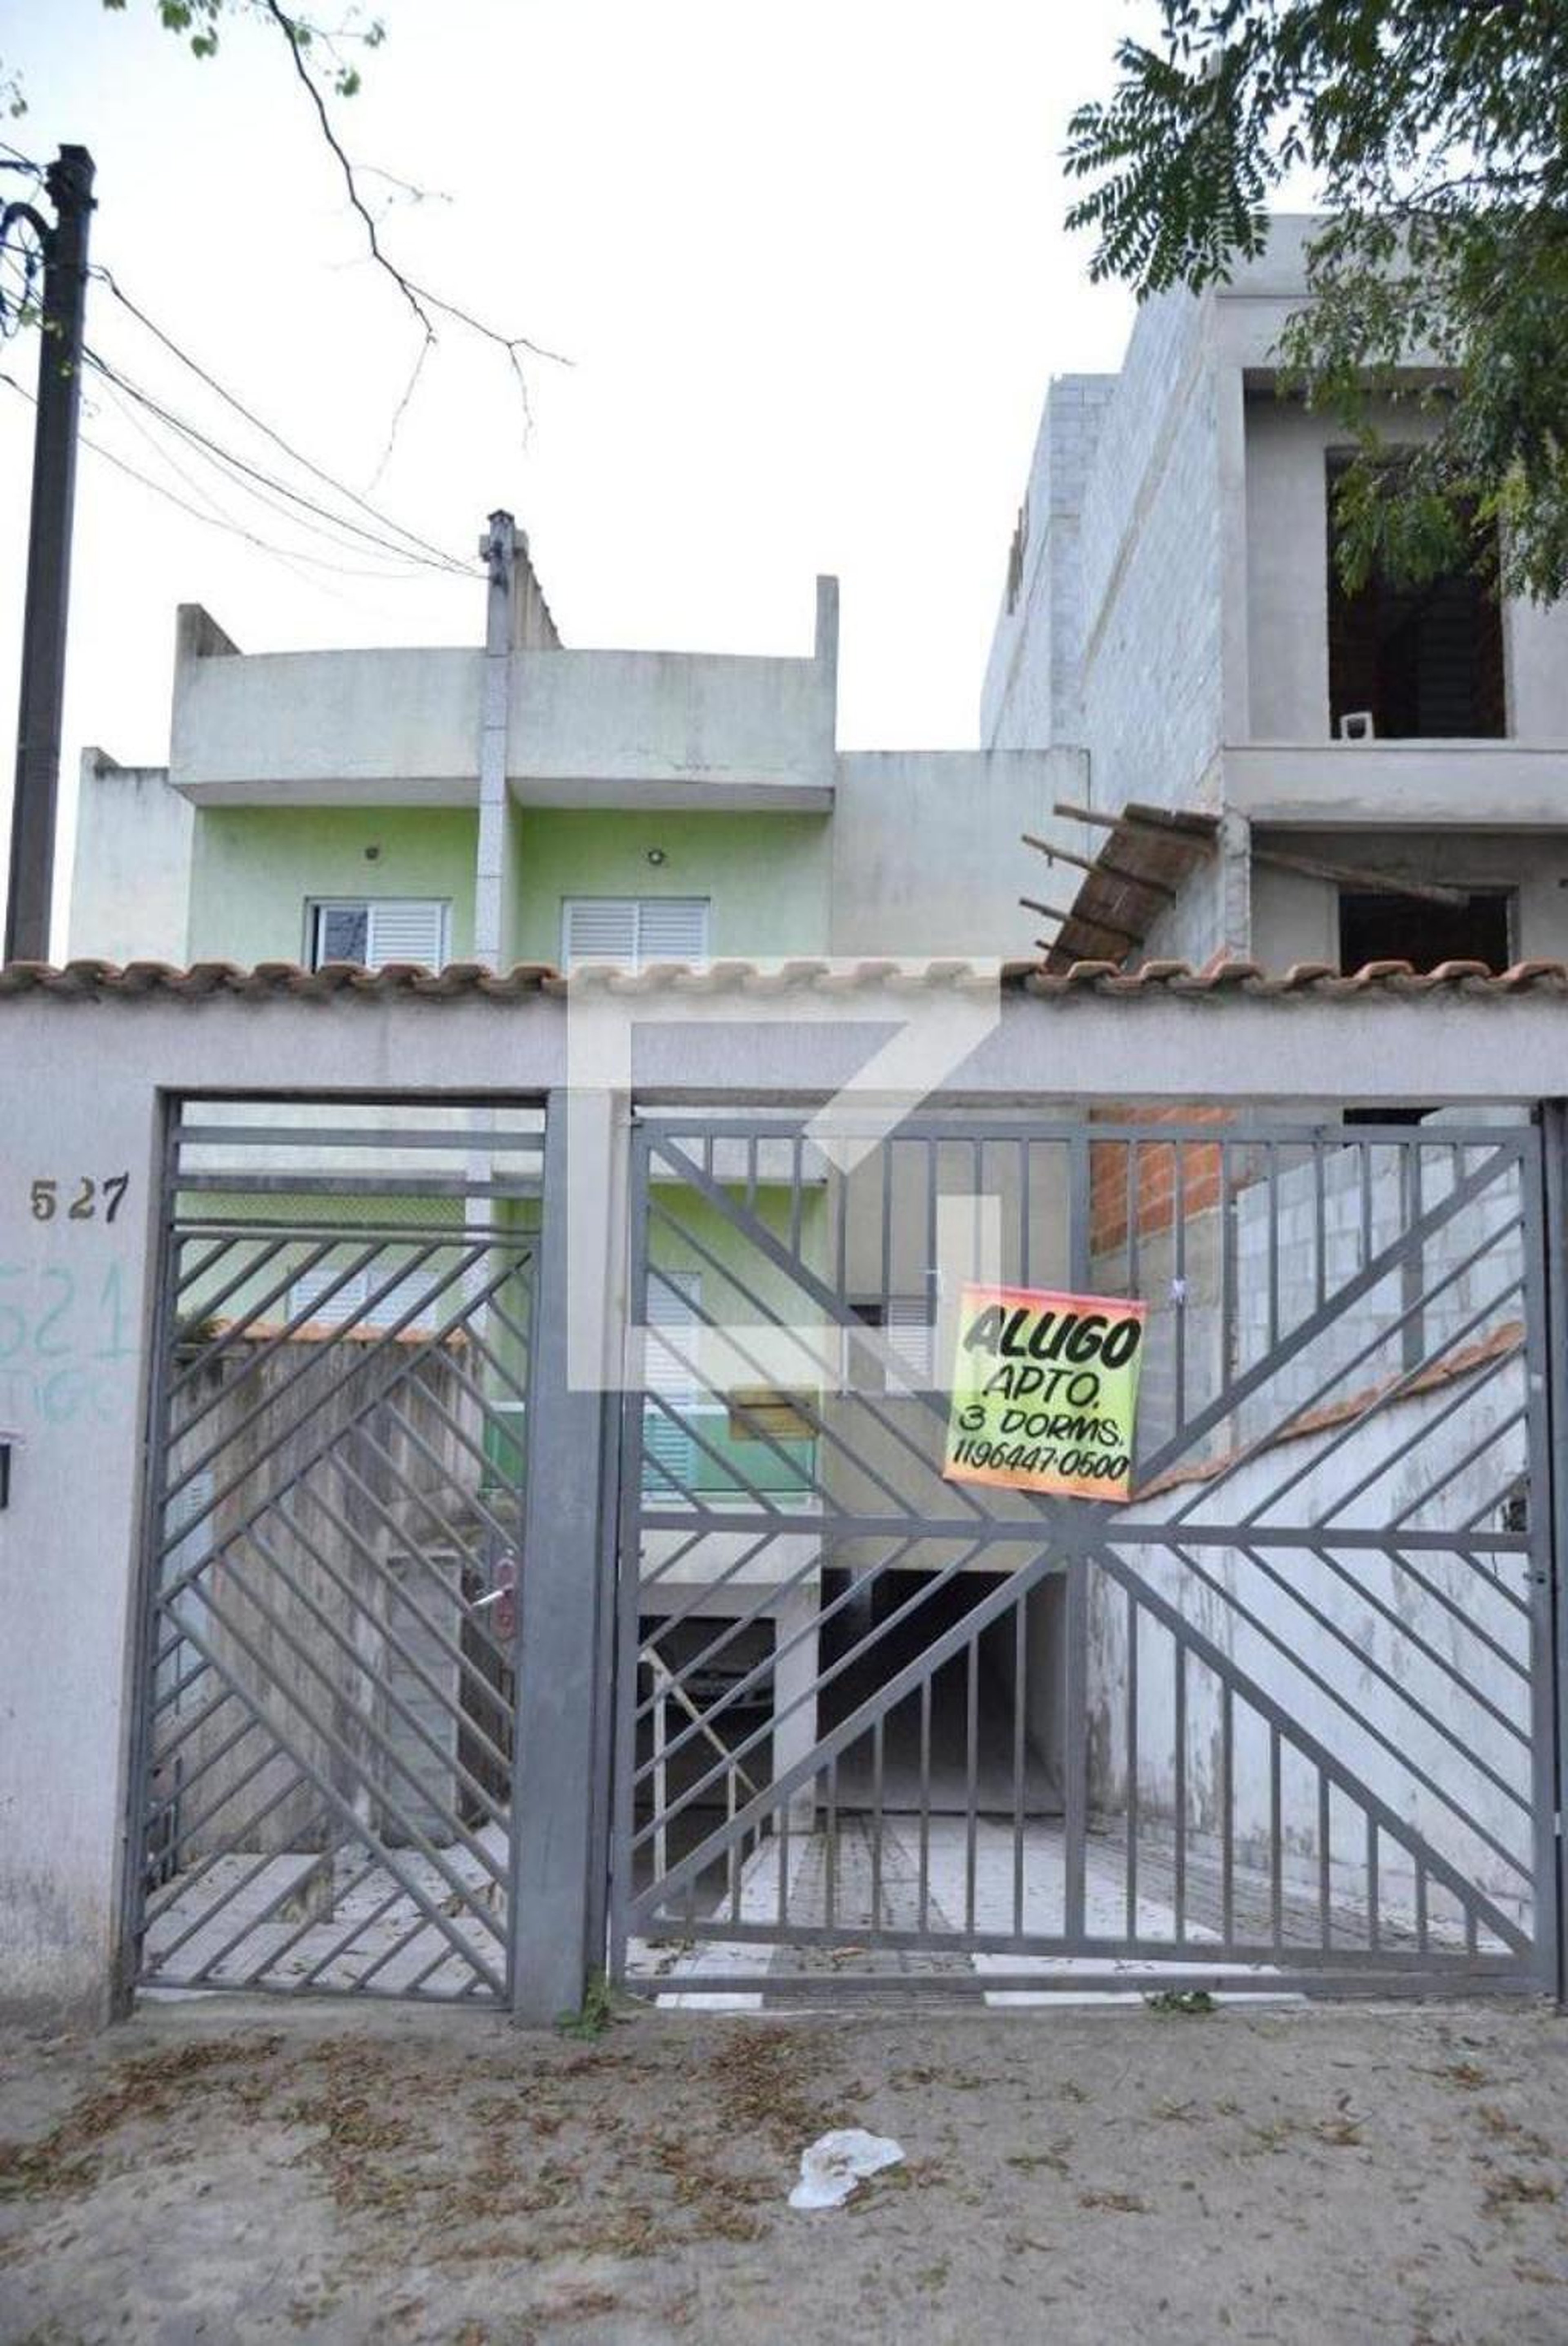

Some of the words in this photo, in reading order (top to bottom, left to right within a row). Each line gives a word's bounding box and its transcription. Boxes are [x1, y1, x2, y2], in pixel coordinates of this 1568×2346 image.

[31, 1171, 129, 1223] 527
[963, 1304, 1142, 1369] ALUGO
[959, 1405, 986, 1430] 3
